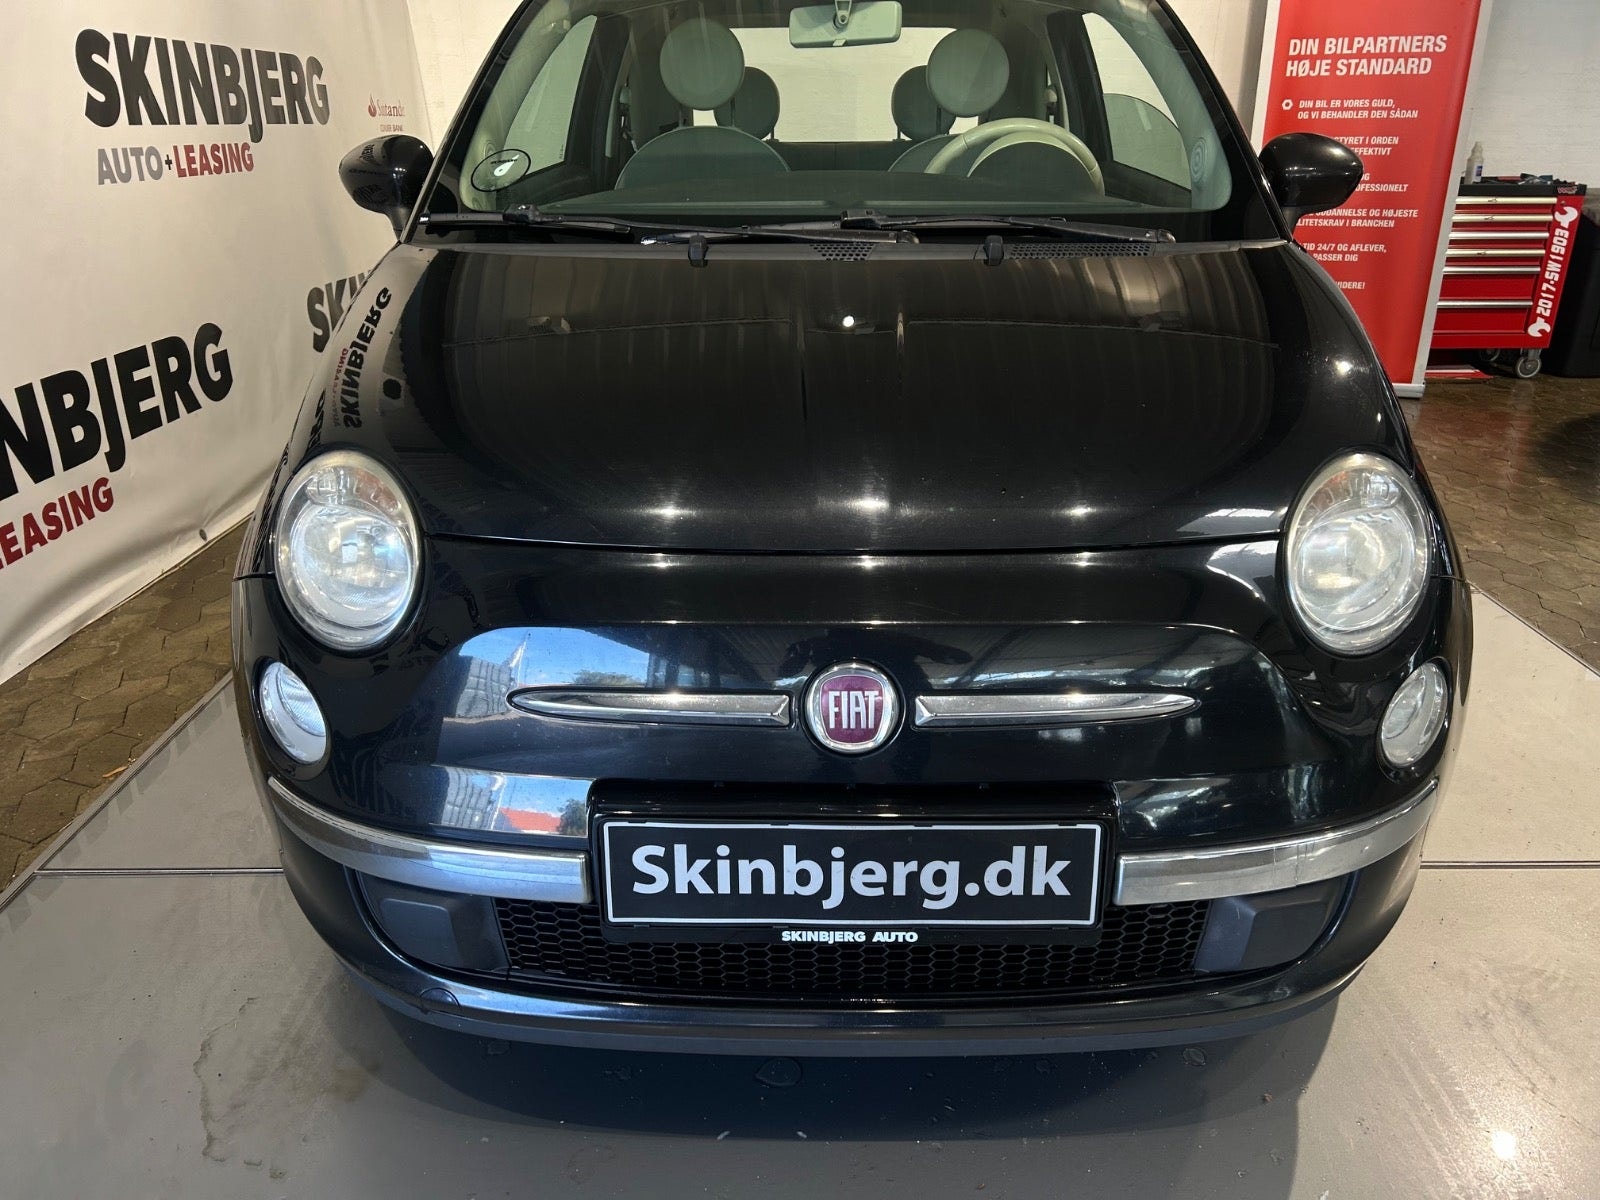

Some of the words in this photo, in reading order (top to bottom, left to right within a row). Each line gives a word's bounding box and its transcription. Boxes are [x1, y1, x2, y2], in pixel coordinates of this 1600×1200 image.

[1288, 38, 1320, 56] DIN
[1324, 35, 1448, 55] BILPARTNERS
[1286, 59, 1332, 77] HØJE
[1335, 57, 1432, 76] STANDARD
[75, 28, 331, 143] SKINBJERG
[1299, 100, 1314, 109] DIN
[1315, 99, 1329, 108] BIL
[1330, 99, 1342, 108] ER
[1343, 99, 1370, 108] VORES
[1371, 98, 1396, 109] GULD,
[1298, 111, 1309, 119] OG
[1311, 111, 1320, 119] VI
[1321, 110, 1369, 119] BEHANDLER
[1370, 110, 1388, 119] DEN
[1389, 108, 1419, 119] SÅDAN
[1365, 136, 1370, 145] I
[1371, 136, 1399, 145] ORDEN
[1351, 147, 1392, 156] FFEKTIVT
[1369, 209, 1380, 217] OG
[1382, 209, 1419, 218] HØJESTE
[1296, 218, 1345, 227] LITETSKRAV
[1345, 219, 1350, 227] I
[1351, 219, 1395, 228] BRANCHEN
[1317, 243, 1336, 251] 24/7
[1337, 243, 1349, 252] OG
[1350, 243, 1387, 253] AFLEVER,
[1344, 254, 1359, 262] DIG
[0, 476, 114, 570] EASING
[828, 690, 883, 729] FIAT
[631, 843, 1072, 910] Skinbjerg.dk
[781, 930, 866, 944] SKINBJERG
[872, 931, 919, 943] AUTO
